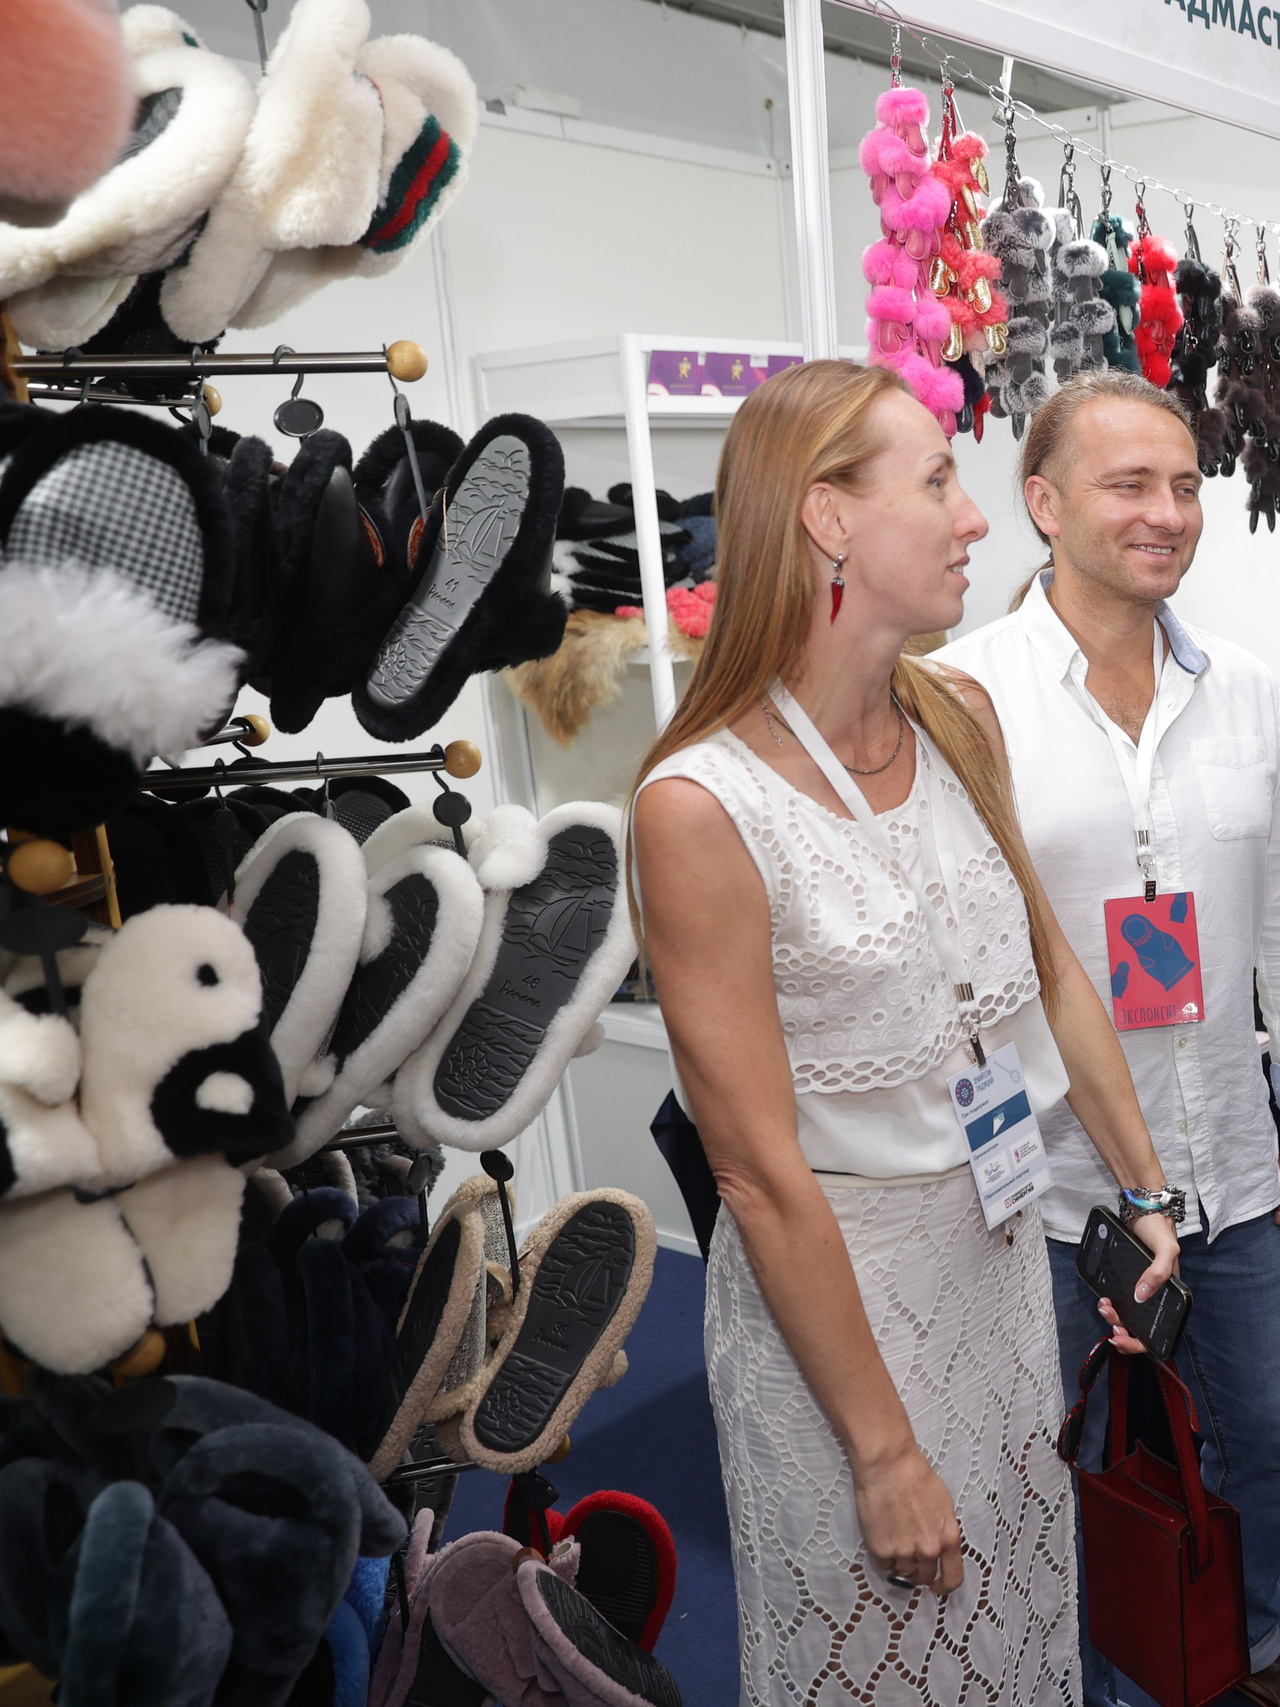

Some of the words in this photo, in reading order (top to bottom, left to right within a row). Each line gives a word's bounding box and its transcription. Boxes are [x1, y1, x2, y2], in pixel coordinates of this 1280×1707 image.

[521, 974, 540, 989] 46
[1120, 1004, 1177, 1025] ЭКСПОНЕНТ
[1012, 1184, 1035, 1205] СИНЕРГИЯ
